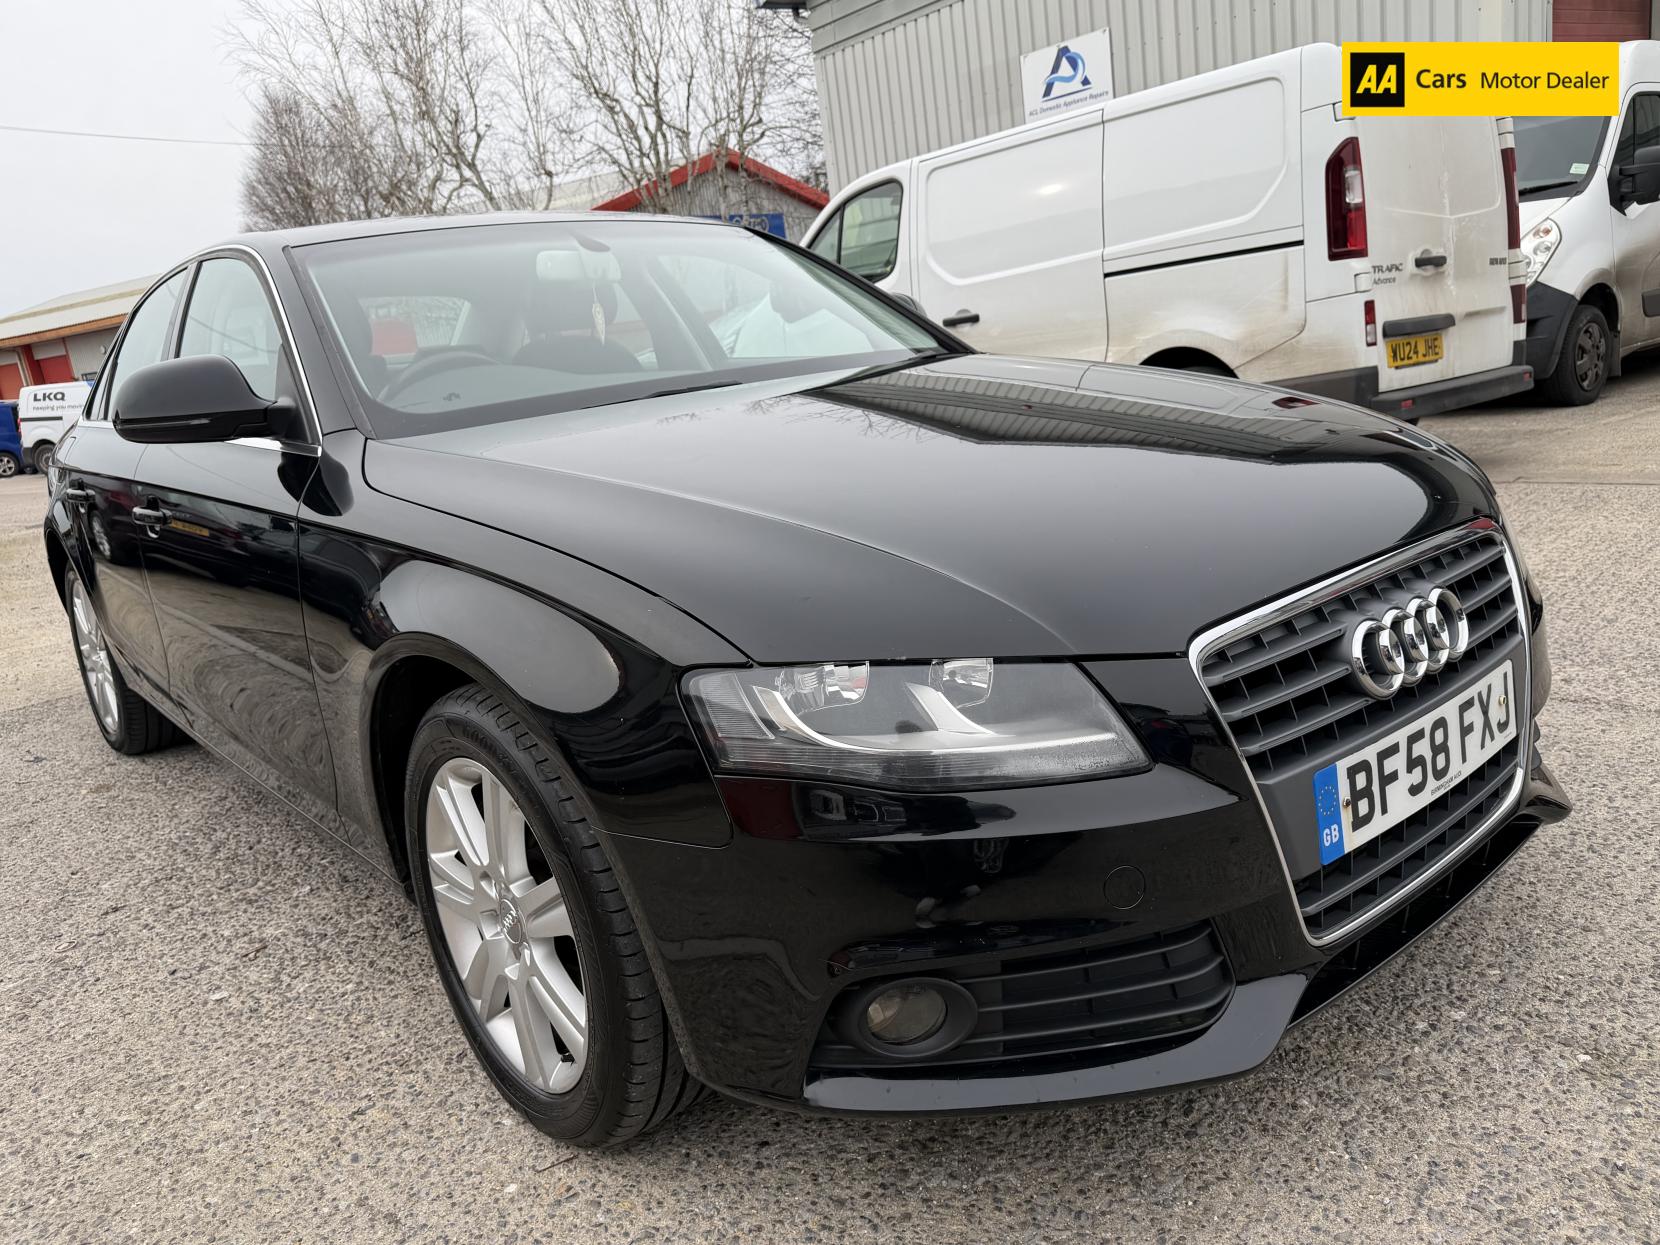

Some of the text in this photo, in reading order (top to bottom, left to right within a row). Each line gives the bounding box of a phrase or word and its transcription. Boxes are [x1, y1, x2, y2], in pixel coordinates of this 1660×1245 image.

[1371, 263, 1404, 274] TRAFIC
[1391, 337, 1440, 363] WU24 JHE
[33, 391, 66, 402] LKQ
[1346, 671, 1511, 833] BF58 FXJ
[1323, 824, 1339, 847] GB
